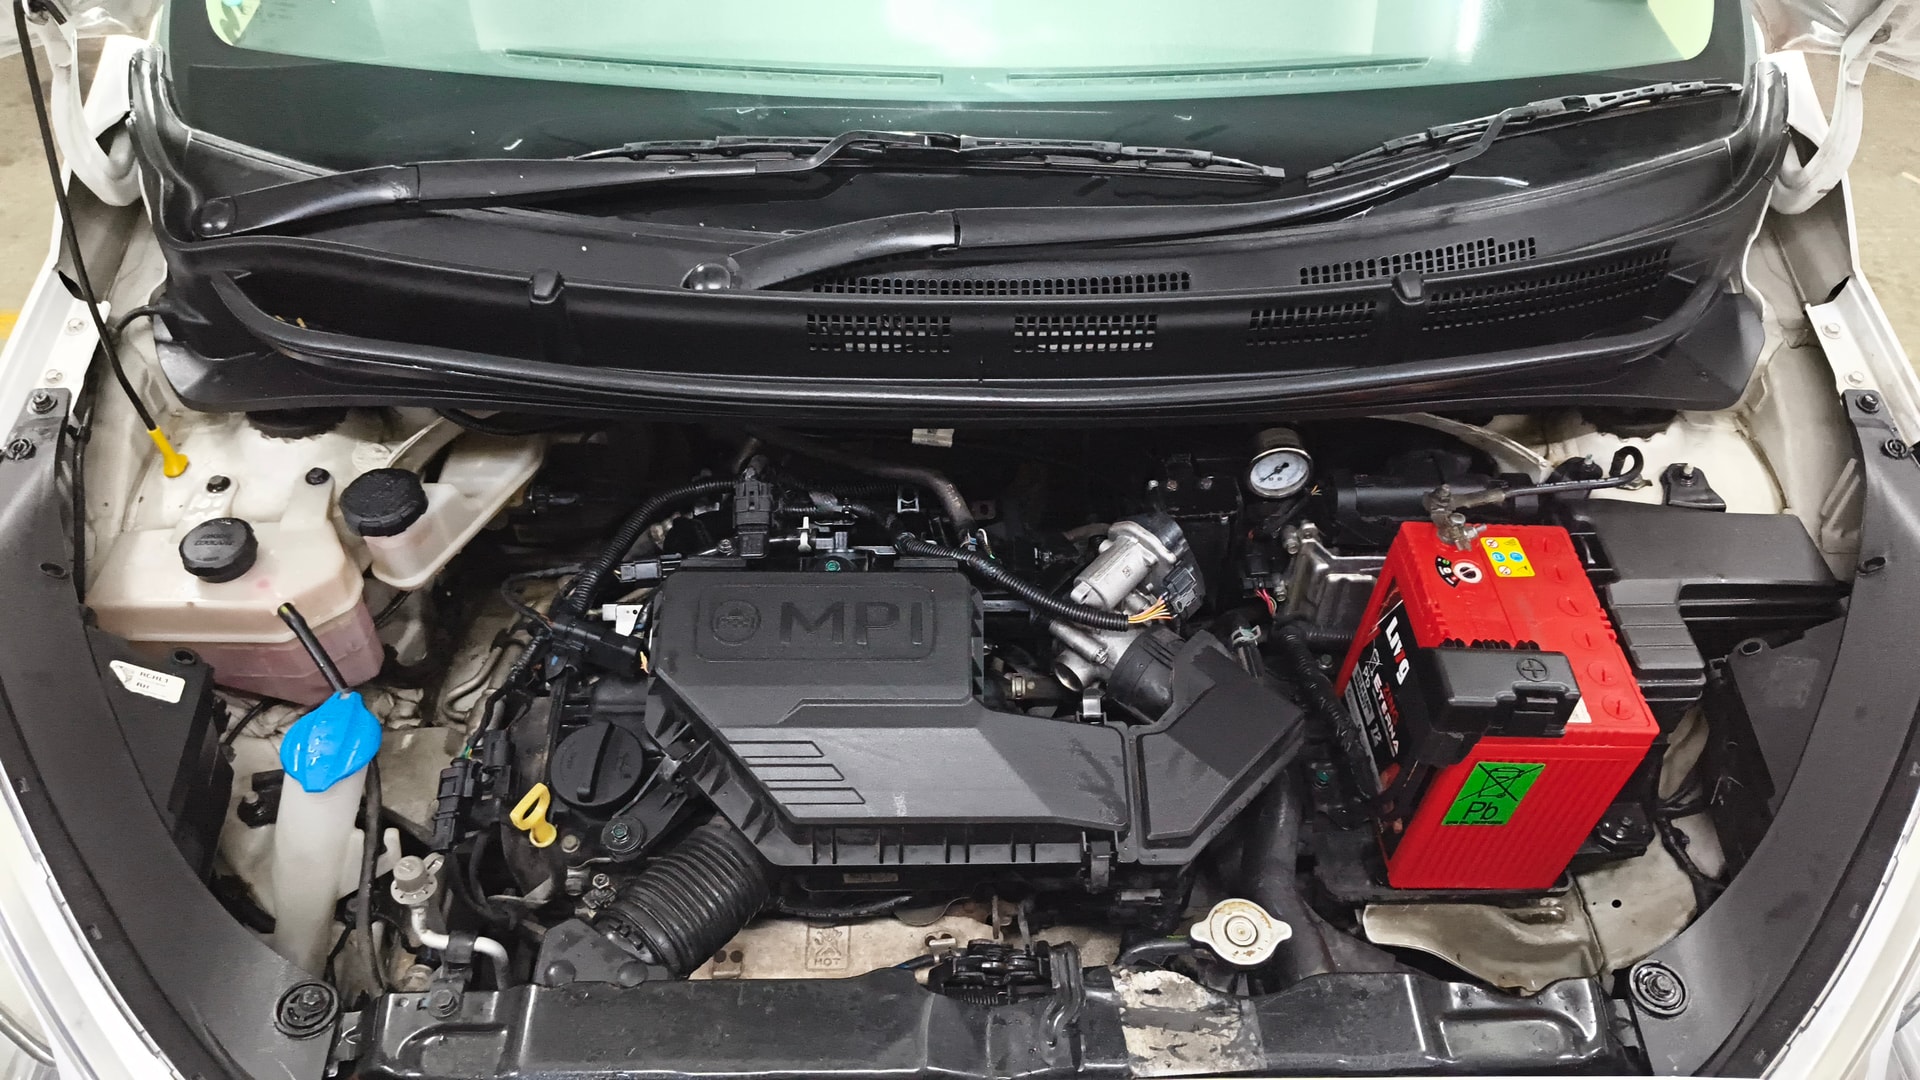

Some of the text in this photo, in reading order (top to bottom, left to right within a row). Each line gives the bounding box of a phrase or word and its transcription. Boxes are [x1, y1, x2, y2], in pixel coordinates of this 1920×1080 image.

[780, 601, 923, 646] MPI
[1462, 801, 1499, 820] Pb
[814, 957, 841, 966] HOT
